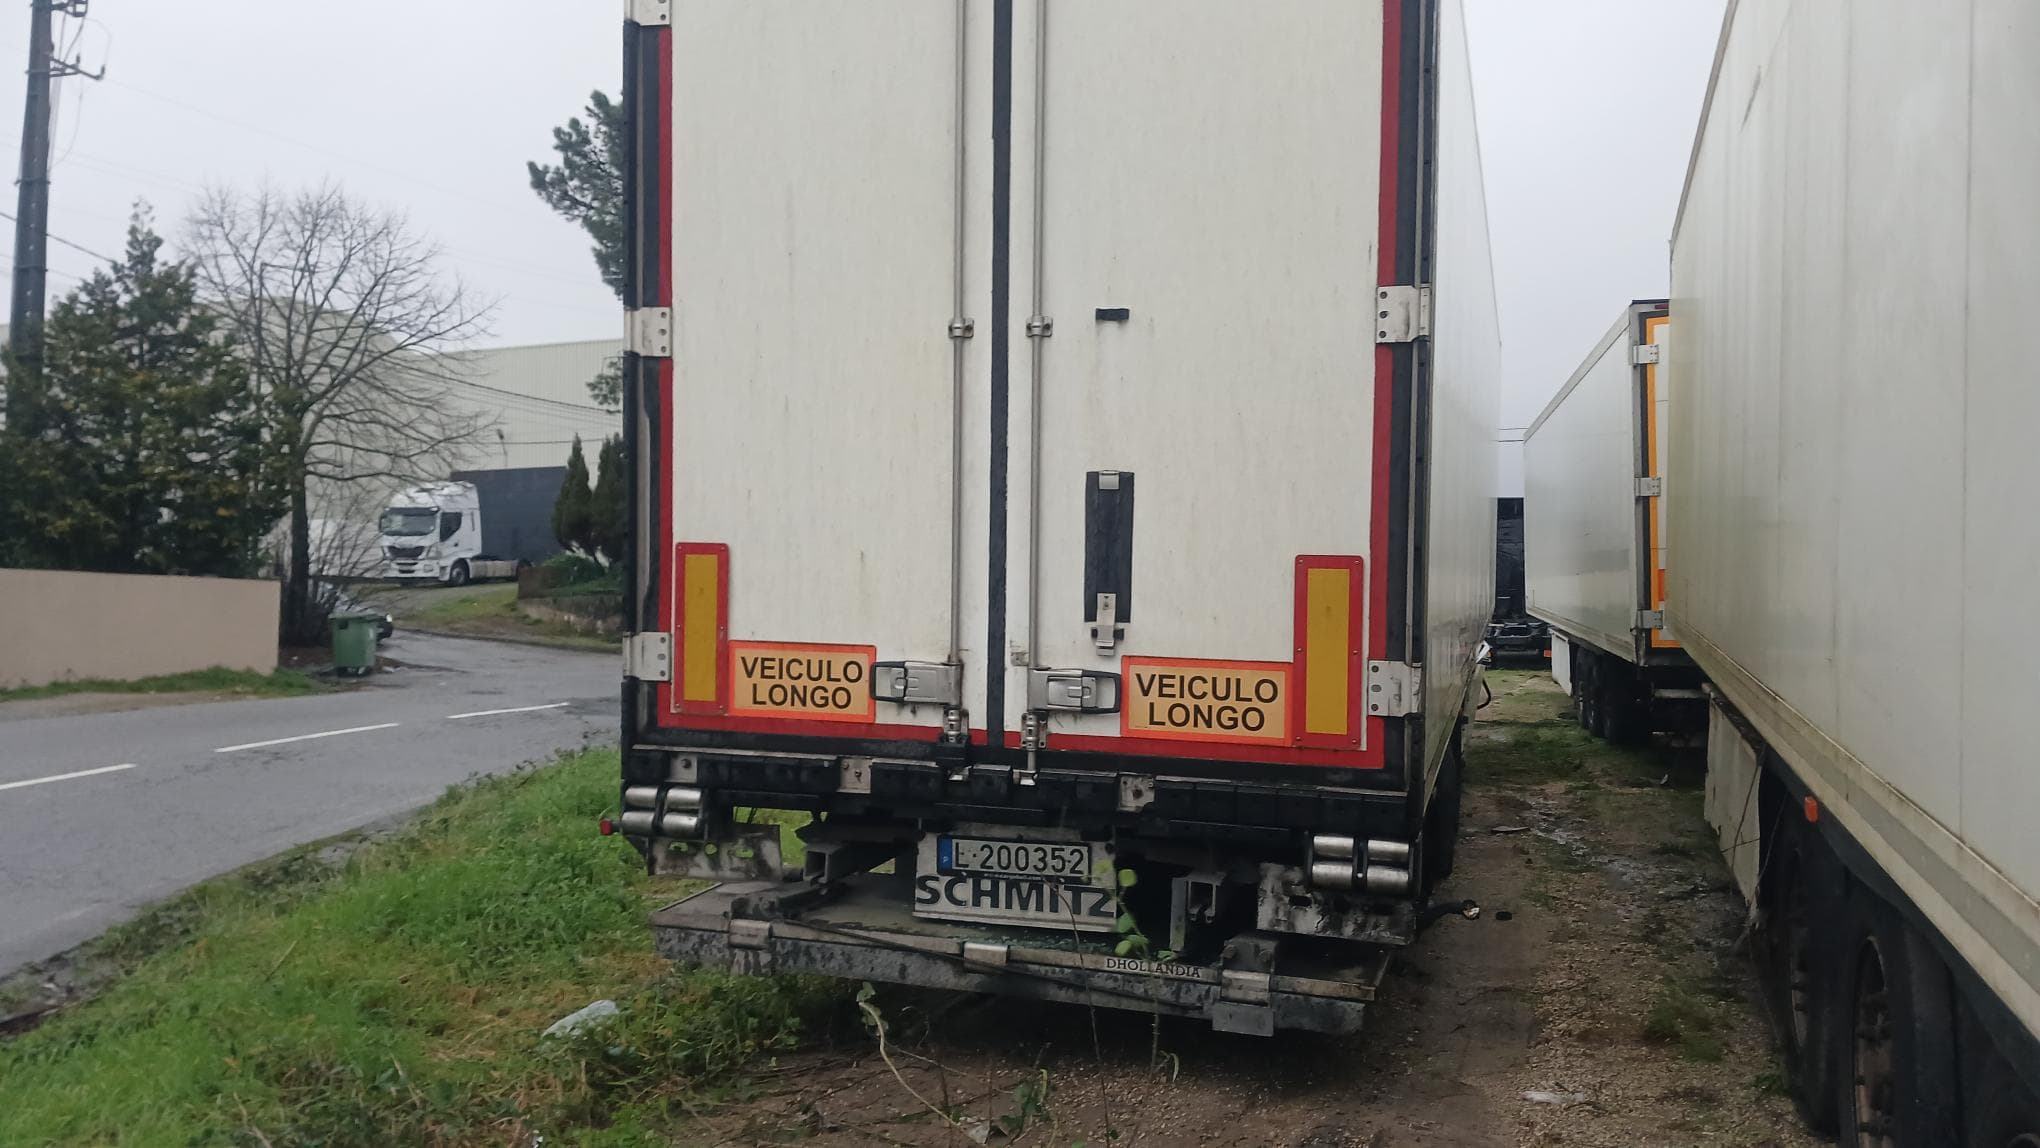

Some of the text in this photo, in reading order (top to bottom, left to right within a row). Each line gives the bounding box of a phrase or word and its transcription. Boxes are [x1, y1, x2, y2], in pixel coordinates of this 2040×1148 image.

[741, 656, 863, 683] VEICULO
[752, 683, 852, 709] LONGO
[1136, 673, 1279, 703] VEICULO
[1149, 702, 1265, 731] LONGO
[915, 875, 1115, 918] SCHMITZ
